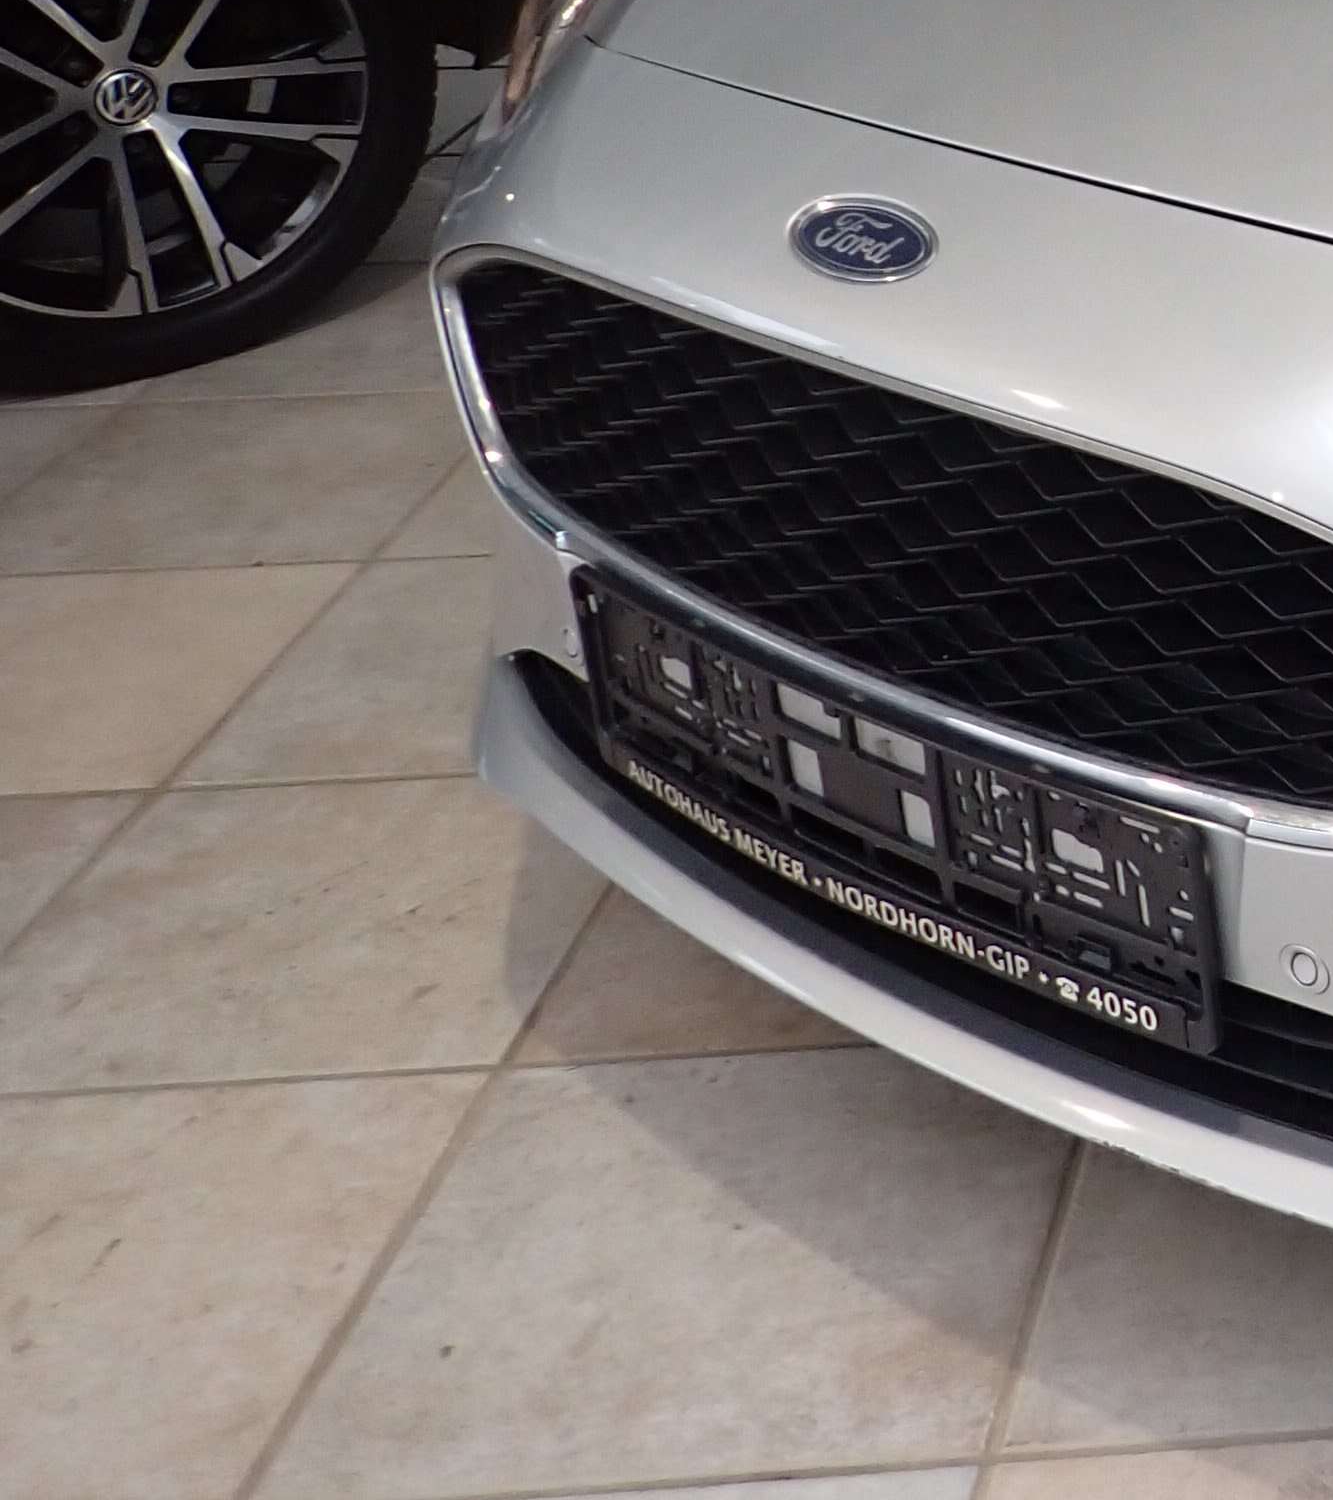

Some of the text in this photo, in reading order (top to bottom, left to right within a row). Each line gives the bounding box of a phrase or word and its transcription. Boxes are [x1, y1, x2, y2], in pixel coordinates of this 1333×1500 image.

[815, 212, 904, 264] Ford
[629, 760, 1158, 1031] AUTOHAUS MEYER NORDHORN-GIP 4050
